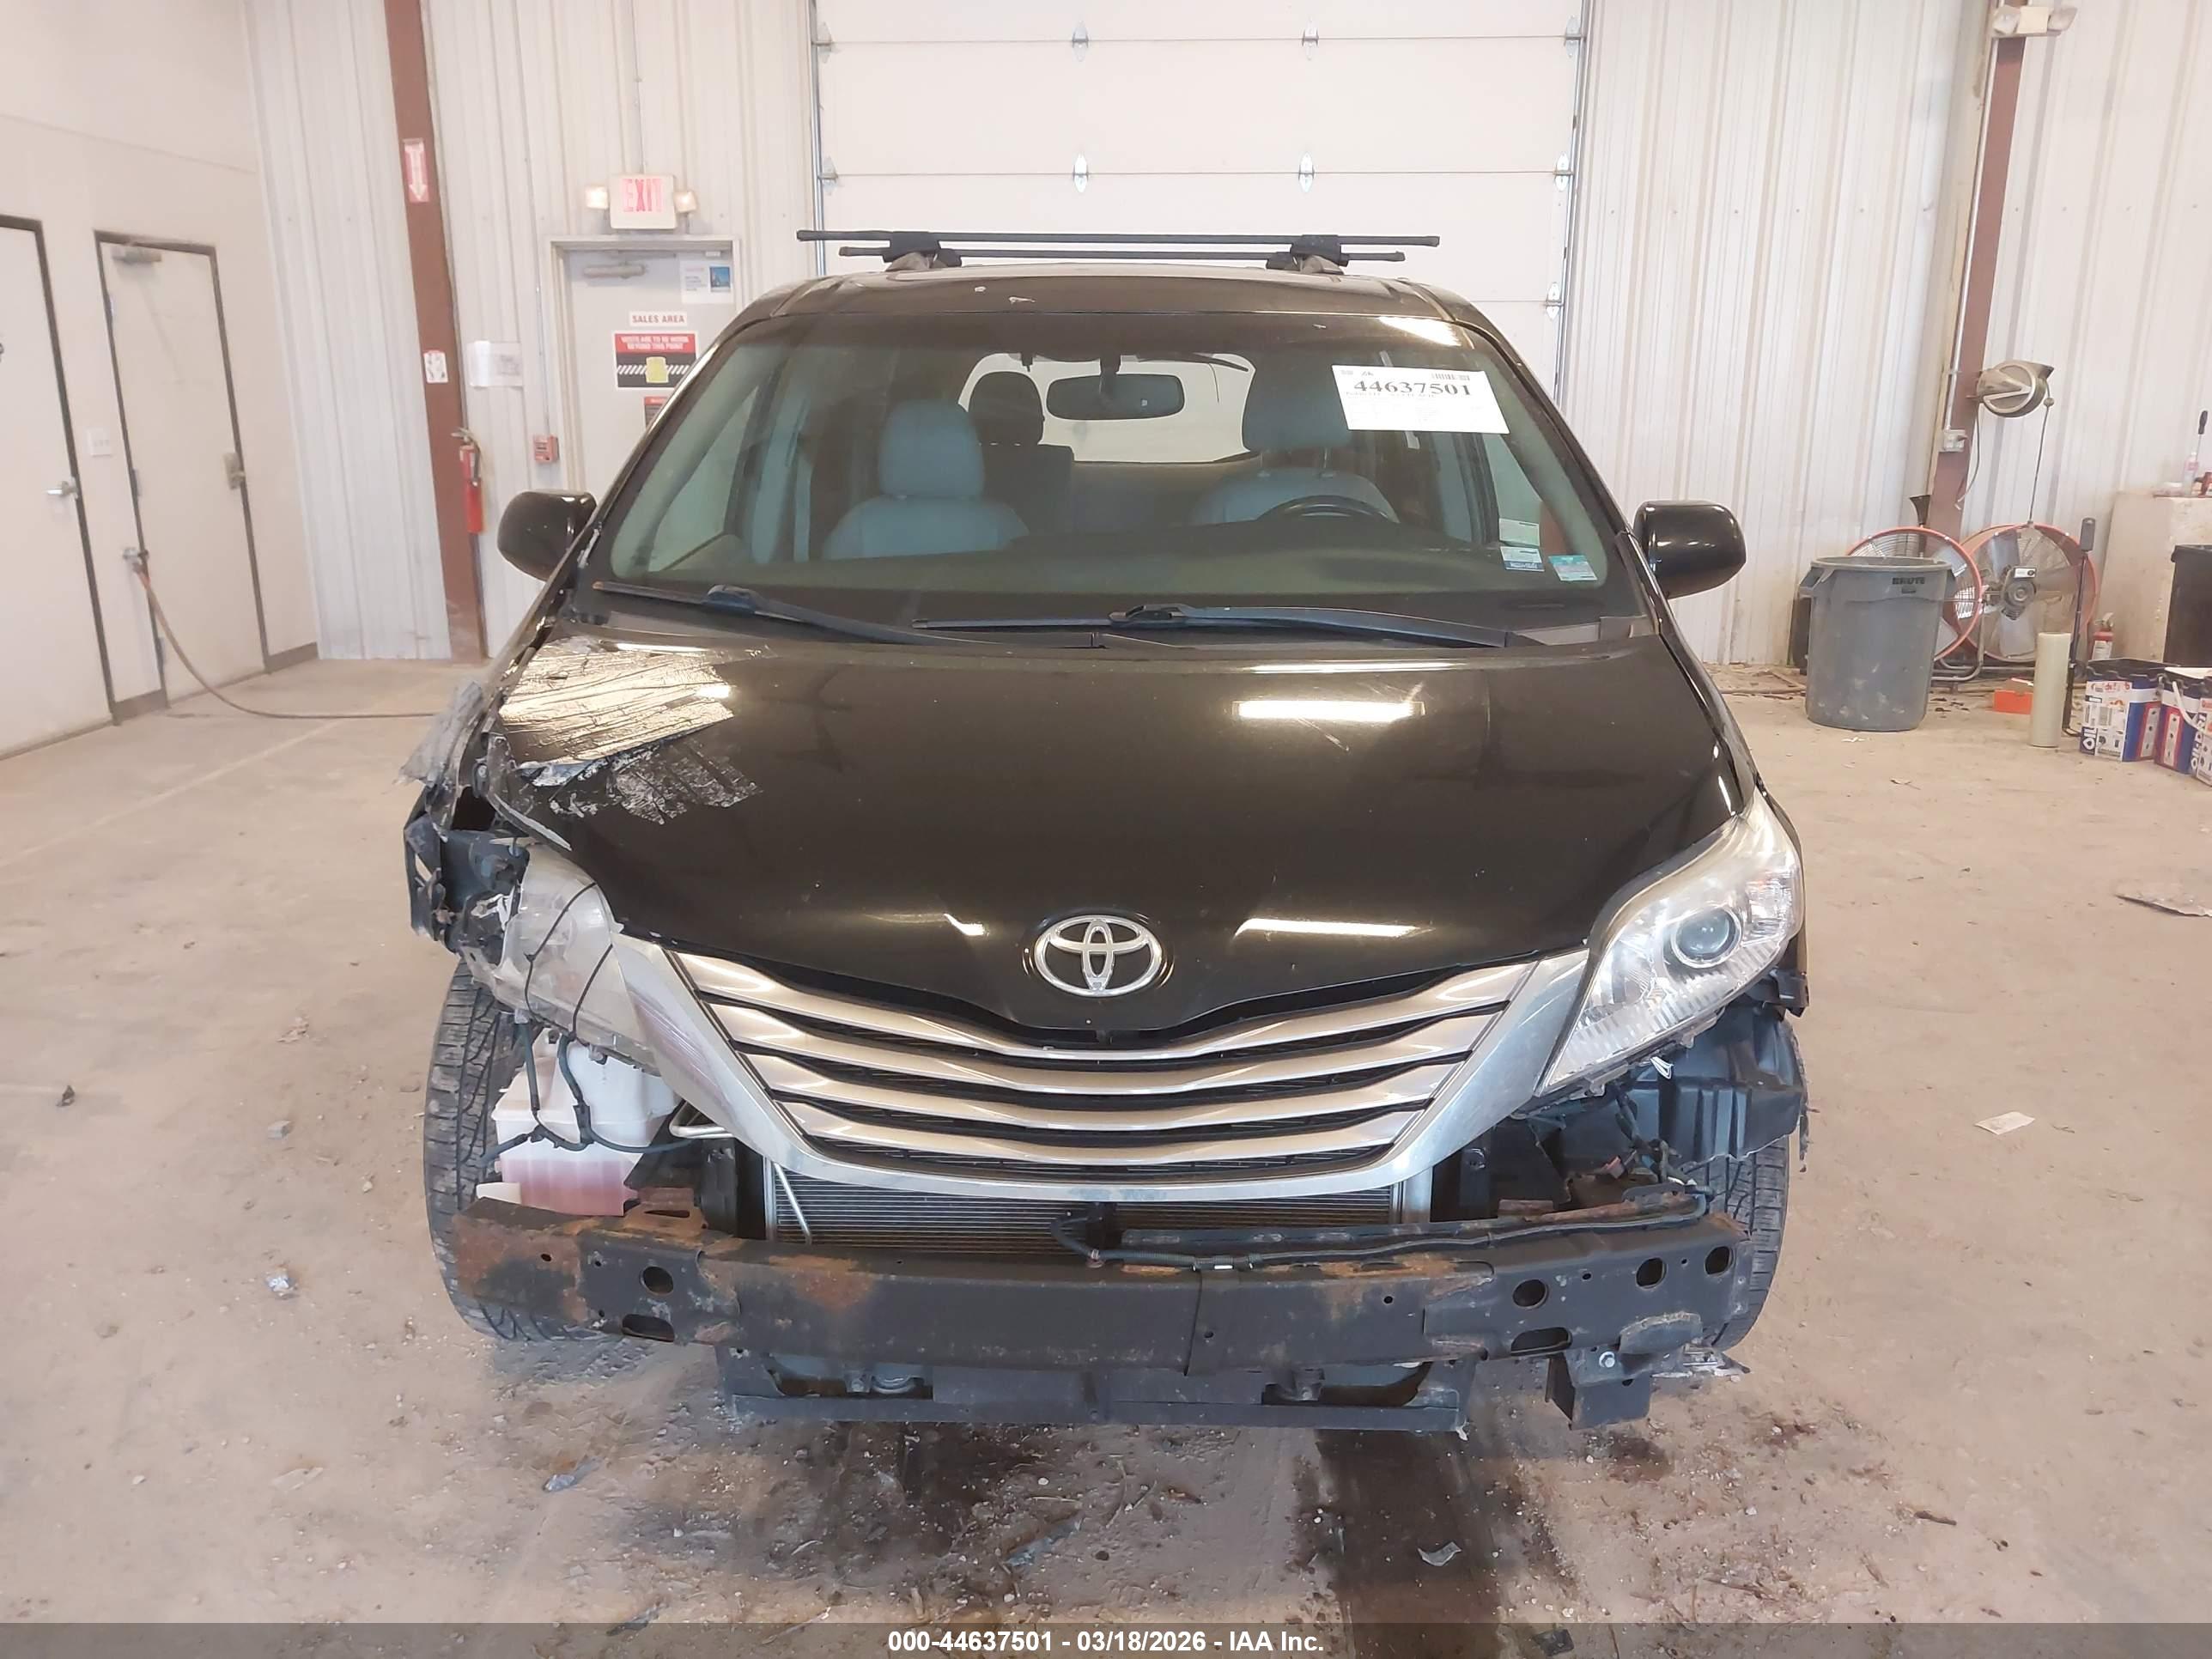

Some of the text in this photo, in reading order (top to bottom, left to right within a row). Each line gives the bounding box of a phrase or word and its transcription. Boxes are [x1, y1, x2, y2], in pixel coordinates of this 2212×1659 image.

[623, 178, 663, 212] EXIT
[632, 314, 685, 324] SALES AREA
[1354, 380, 1471, 396] 44637501
